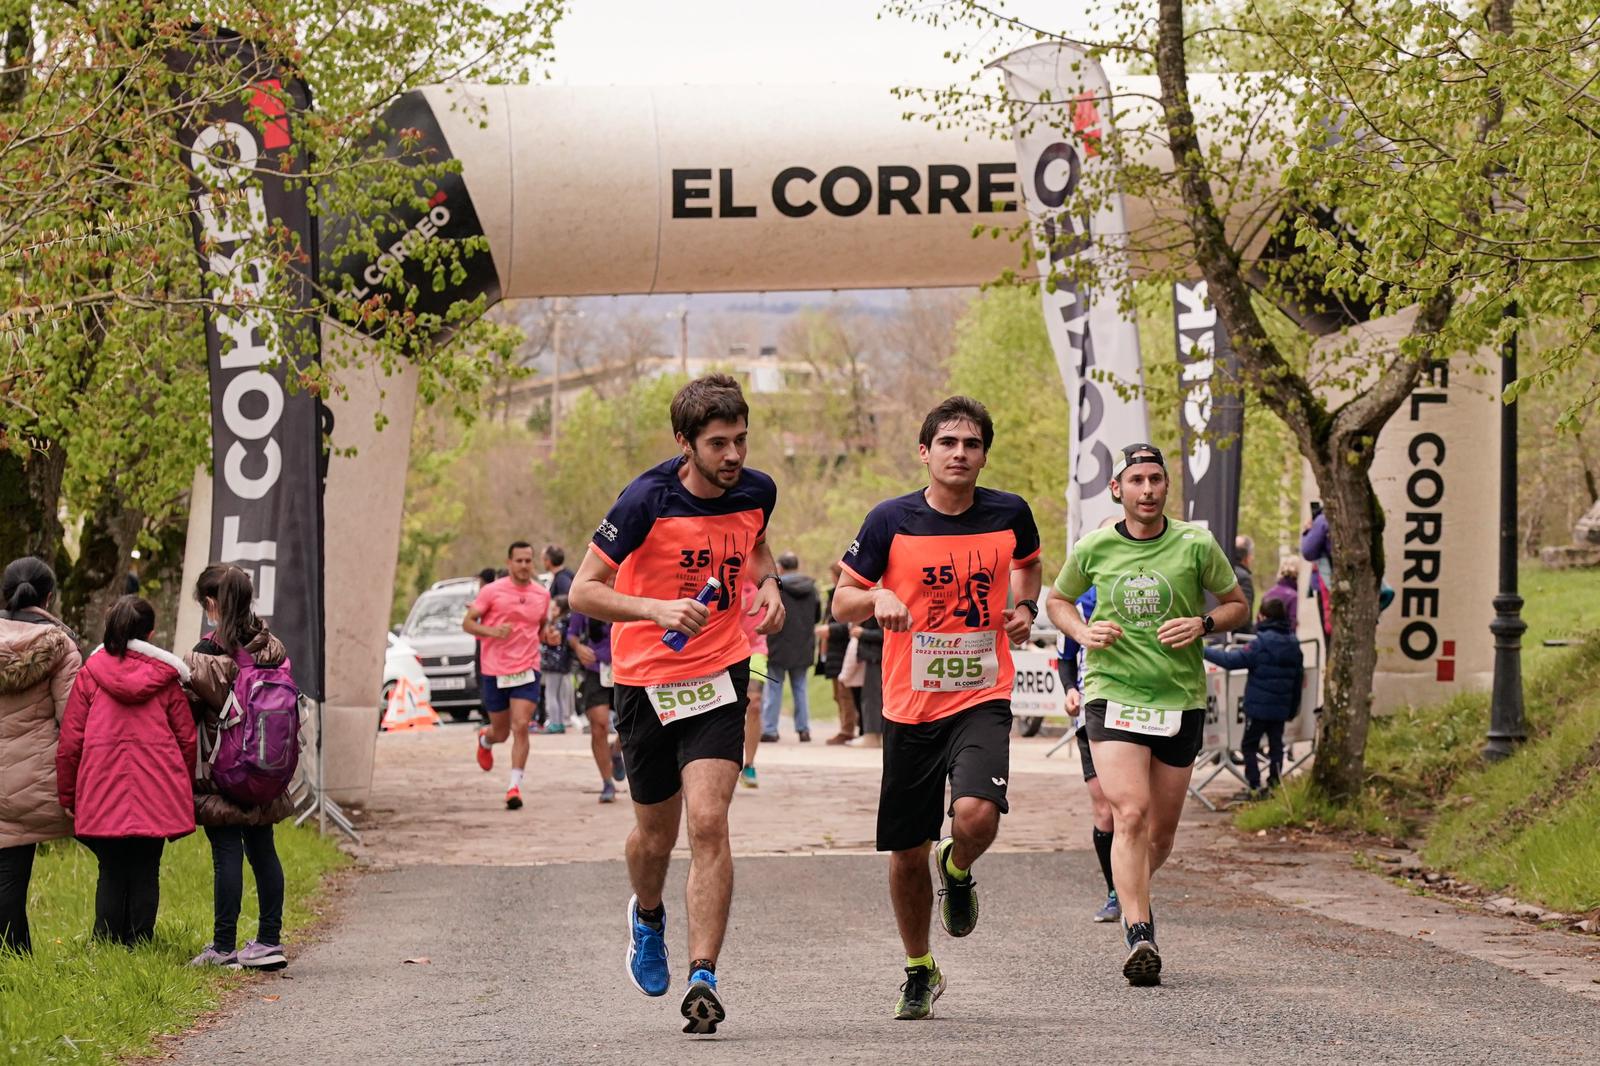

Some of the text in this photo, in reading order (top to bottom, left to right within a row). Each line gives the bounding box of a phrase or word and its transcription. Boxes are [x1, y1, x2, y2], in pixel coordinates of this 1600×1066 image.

[672, 163, 1019, 218] EL CORRE
[1399, 432, 1446, 661] CORREO
[679, 549, 710, 568] 35
[922, 565, 954, 586] 35
[1124, 597, 1160, 605] GASTEIZ
[1125, 604, 1160, 615] TRAIL
[916, 634, 962, 649] Vital
[927, 657, 983, 679] 495
[661, 681, 698, 689] ESTIBALIZ
[1016, 671, 1055, 694] RREO
[656, 683, 716, 710] 508
[1120, 704, 1166, 725] 251
